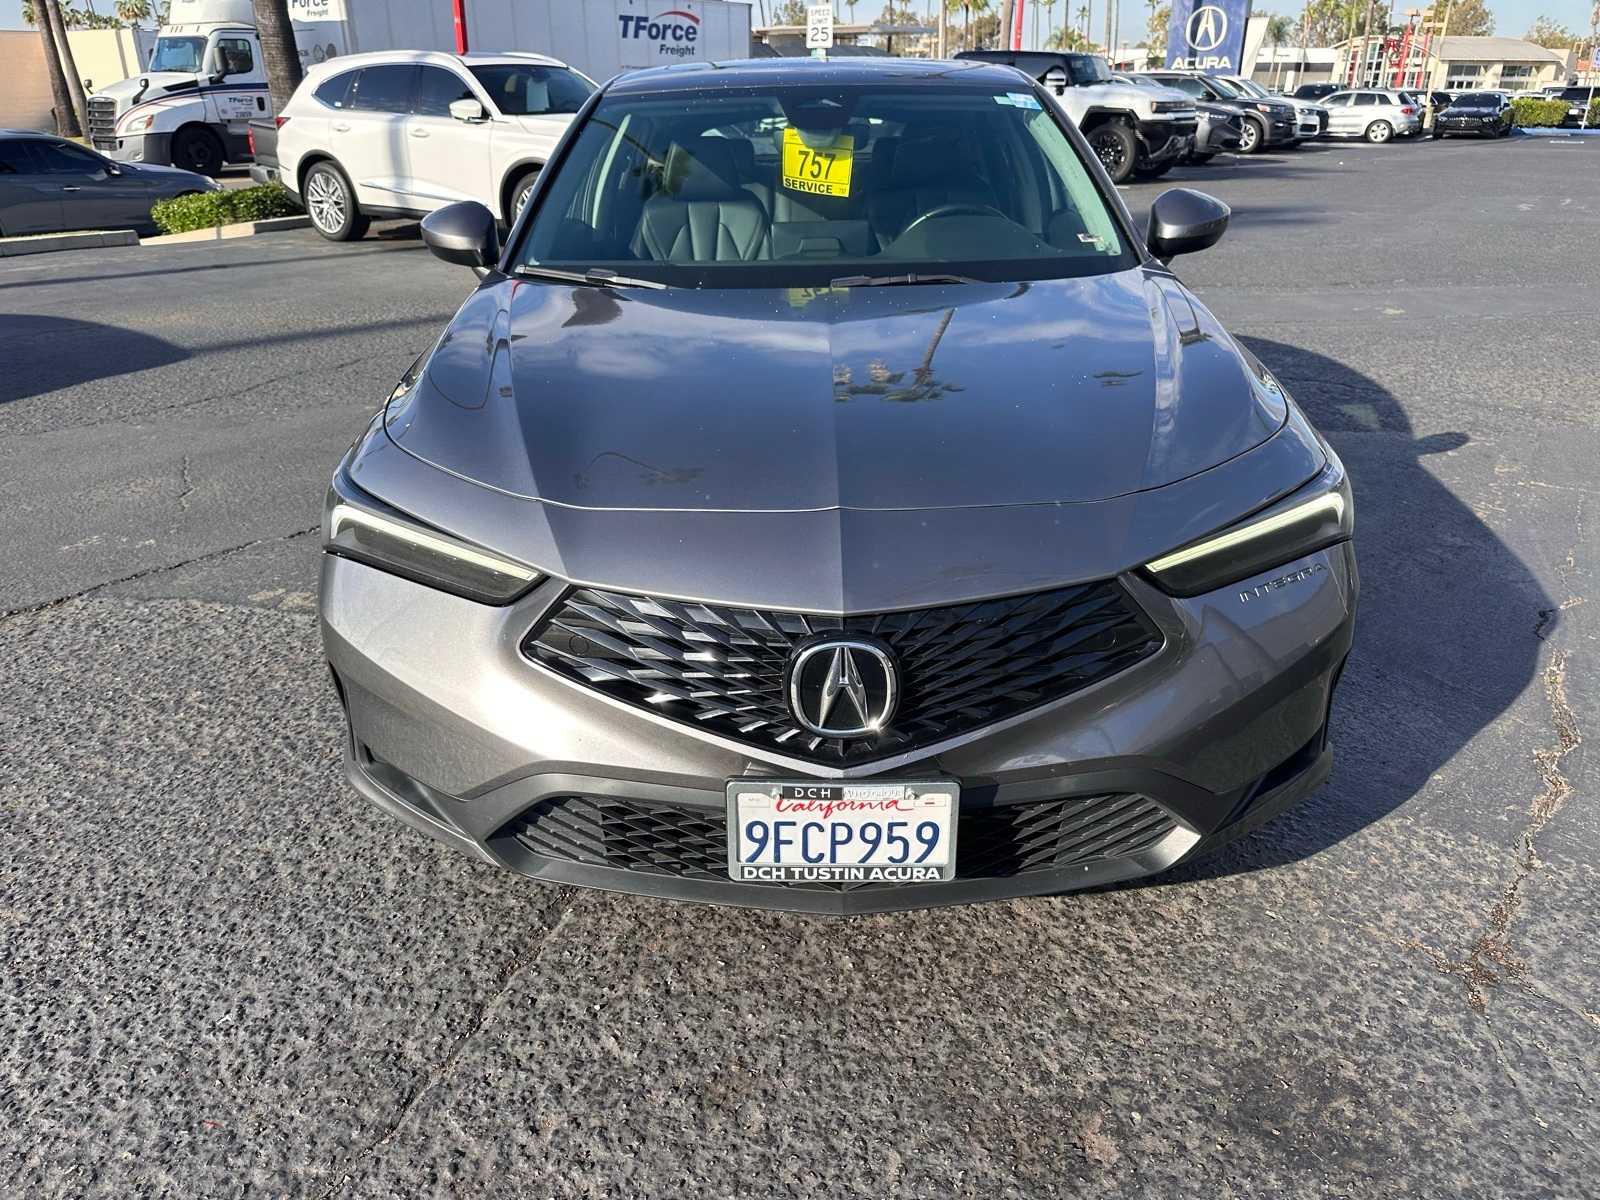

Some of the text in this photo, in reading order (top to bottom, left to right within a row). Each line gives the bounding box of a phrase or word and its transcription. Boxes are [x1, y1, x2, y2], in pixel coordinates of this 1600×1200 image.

[810, 8, 831, 16] SPEED
[618, 14, 698, 42] TForce
[810, 27, 829, 42] 25
[659, 44, 695, 57] Freight
[1171, 55, 1232, 70] ACURA
[798, 150, 836, 180] 757
[785, 178, 833, 194] SERVICE
[1239, 563, 1327, 603] INTEGRA
[794, 787, 831, 798] DCH
[776, 798, 913, 819] California
[745, 820, 940, 864] 9FCP959
[743, 867, 941, 880] DCH TUSTIN ACURA
